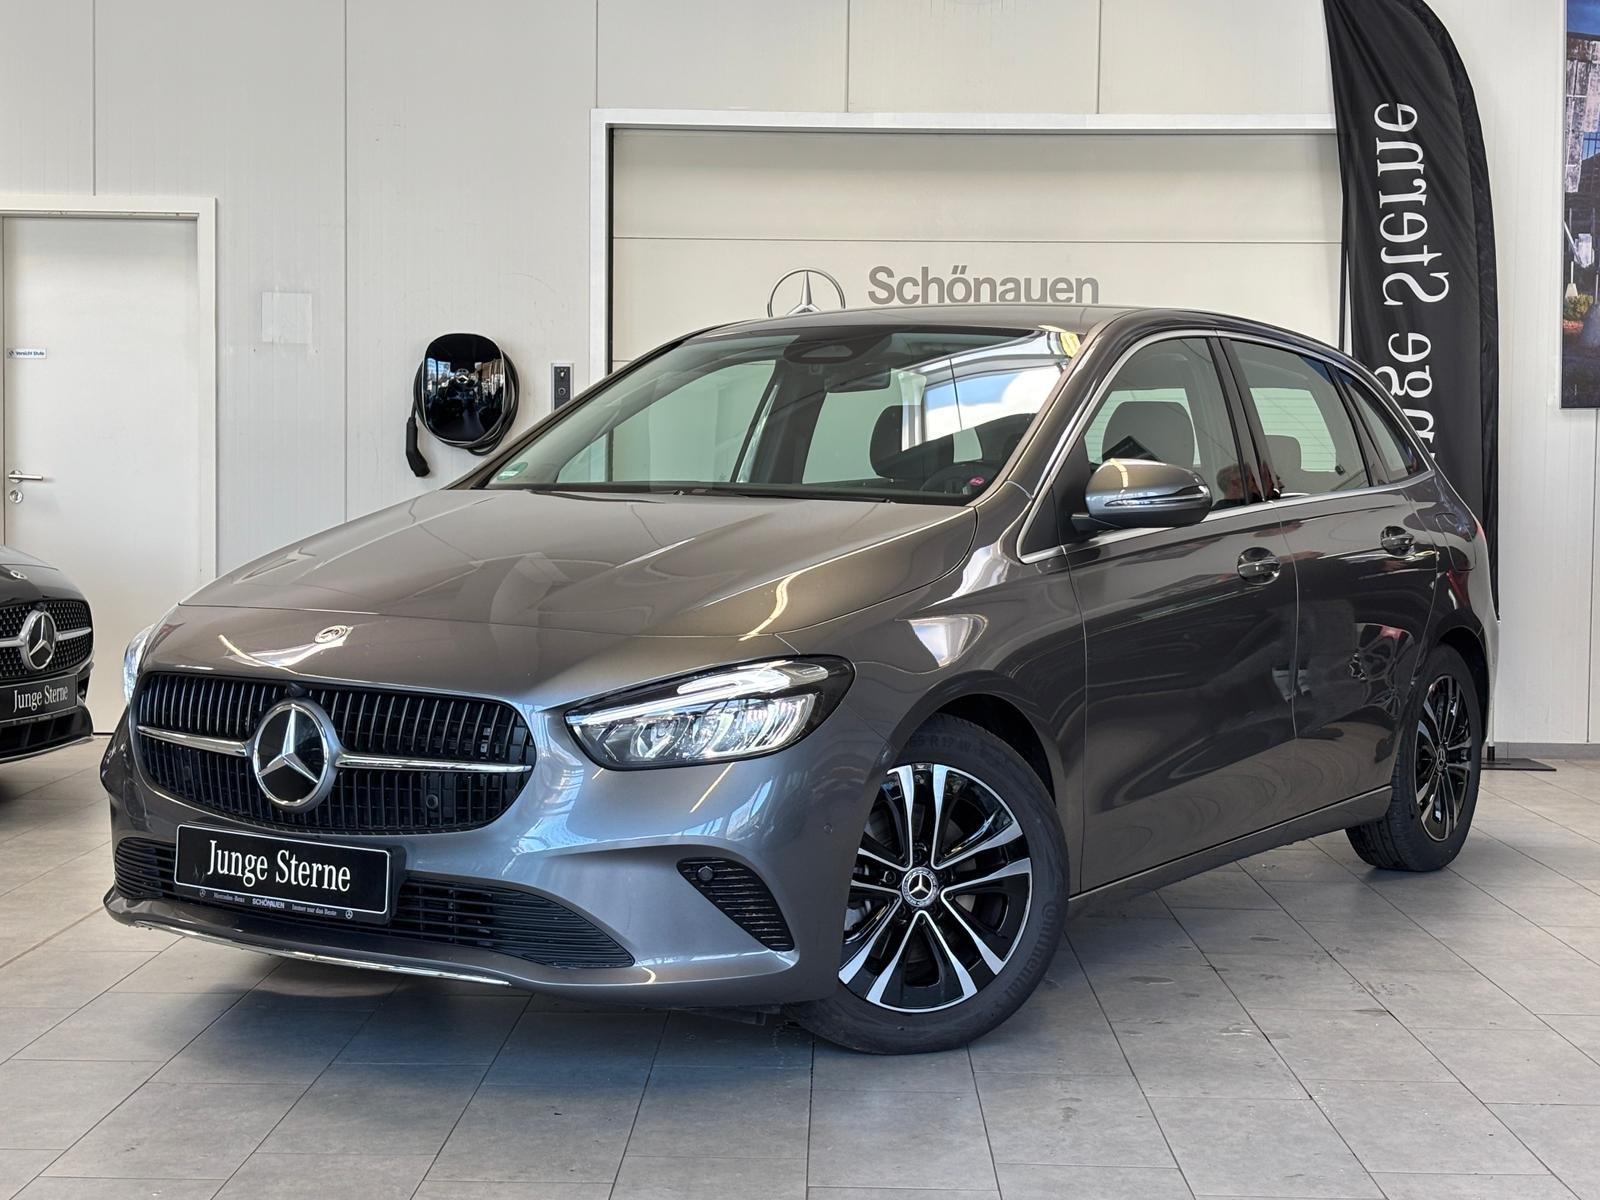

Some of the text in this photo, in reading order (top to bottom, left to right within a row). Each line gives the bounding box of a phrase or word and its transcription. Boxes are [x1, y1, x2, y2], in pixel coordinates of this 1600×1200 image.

[868, 265, 1099, 304] Schönauen
[13, 684, 69, 713] Junge Sterne
[206, 839, 351, 892] Junge Sterne
